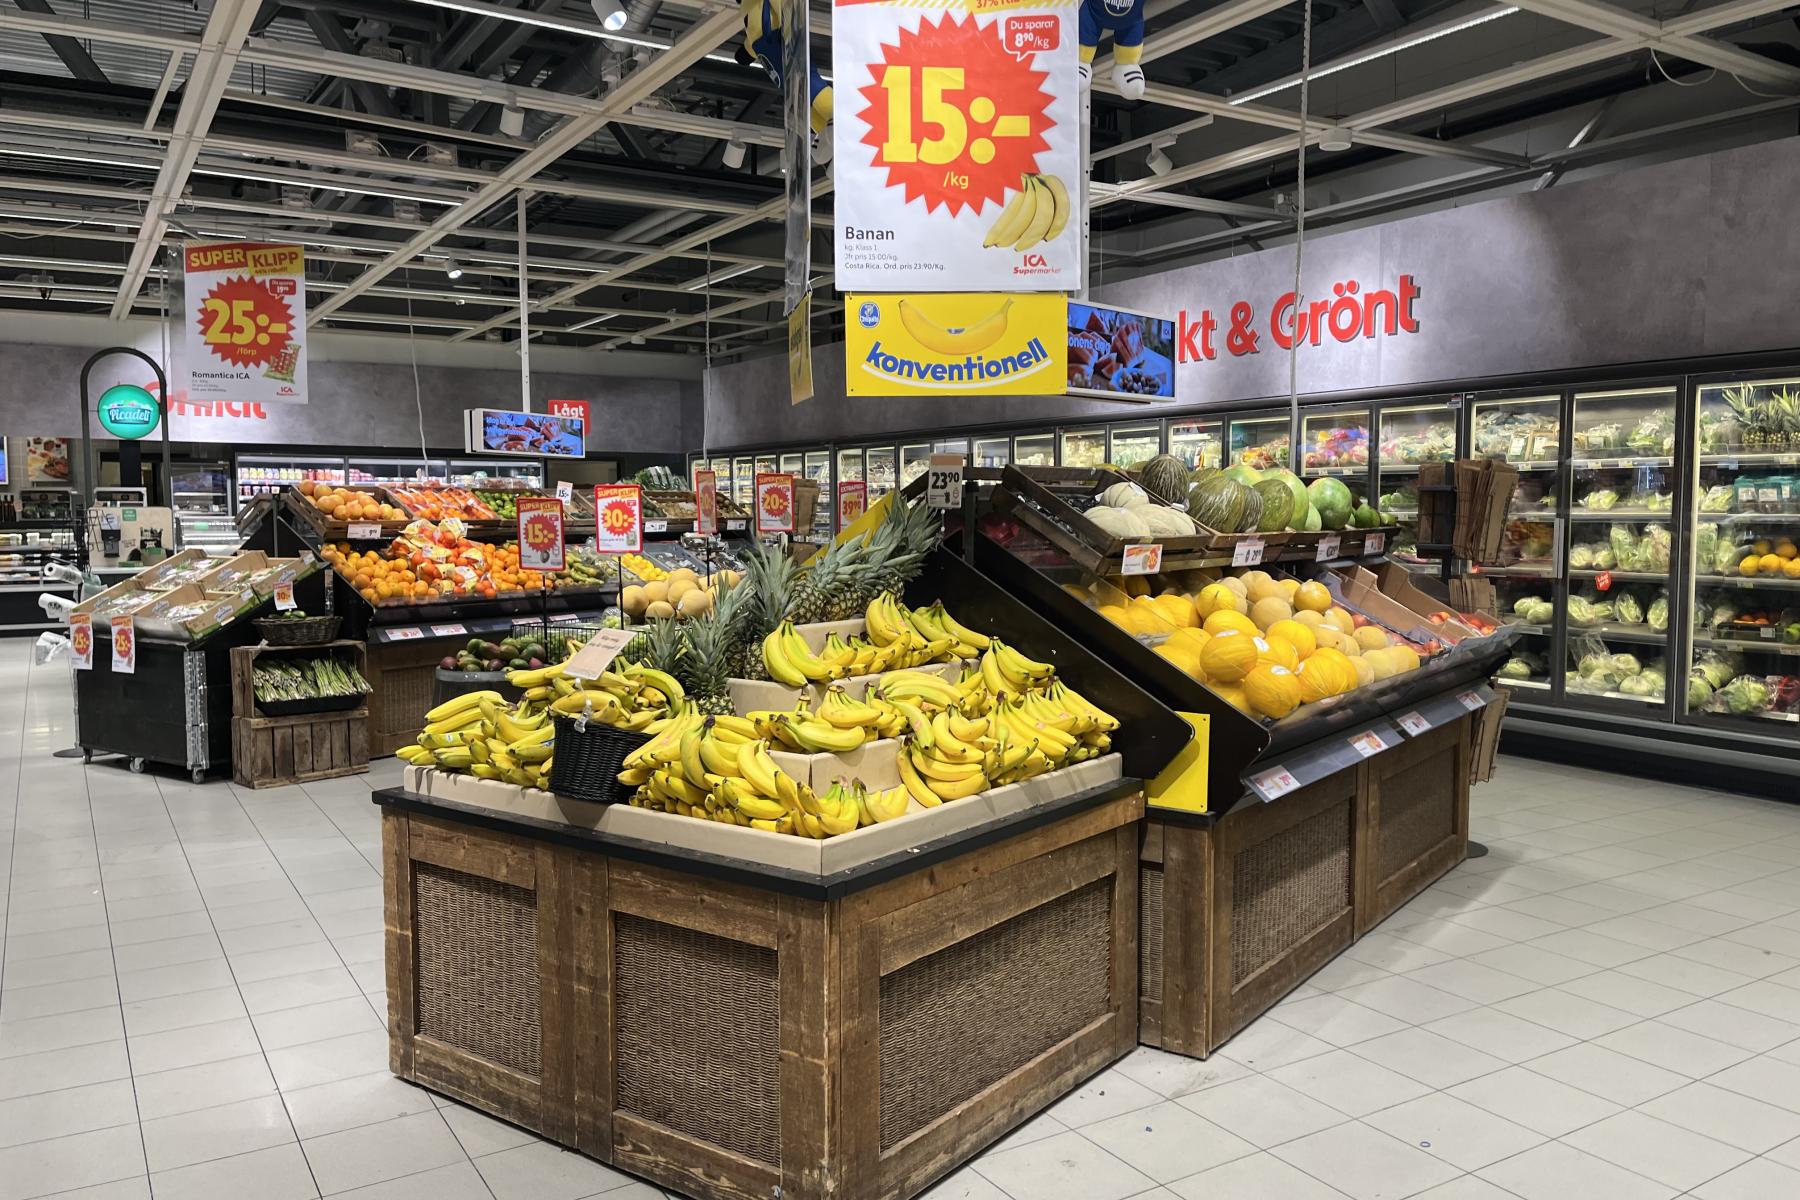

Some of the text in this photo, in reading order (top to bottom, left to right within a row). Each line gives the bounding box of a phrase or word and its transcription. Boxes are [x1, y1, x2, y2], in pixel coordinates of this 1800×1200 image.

[1010, 20, 1054, 31] Du sparar
[880, 66, 1031, 165] 15:-
[943, 172, 969, 188] /kg
[845, 226, 895, 240] Banan
[190, 249, 299, 268] SUPER KLIPP
[844, 262, 864, 270] Costa
[900, 263, 912, 271] pris
[1023, 254, 1048, 268] ICA
[204, 298, 287, 345] 25:-
[1226, 300, 1260, 358] &
[1269, 274, 1420, 350] Grönt
[866, 337, 1049, 382] konventionell
[192, 371, 250, 380] Romantica ICA
[554, 403, 584, 417] Lågt
[763, 493, 789, 510] 20:-
[603, 508, 635, 528] 30:-
[527, 523, 555, 544] 15:-
